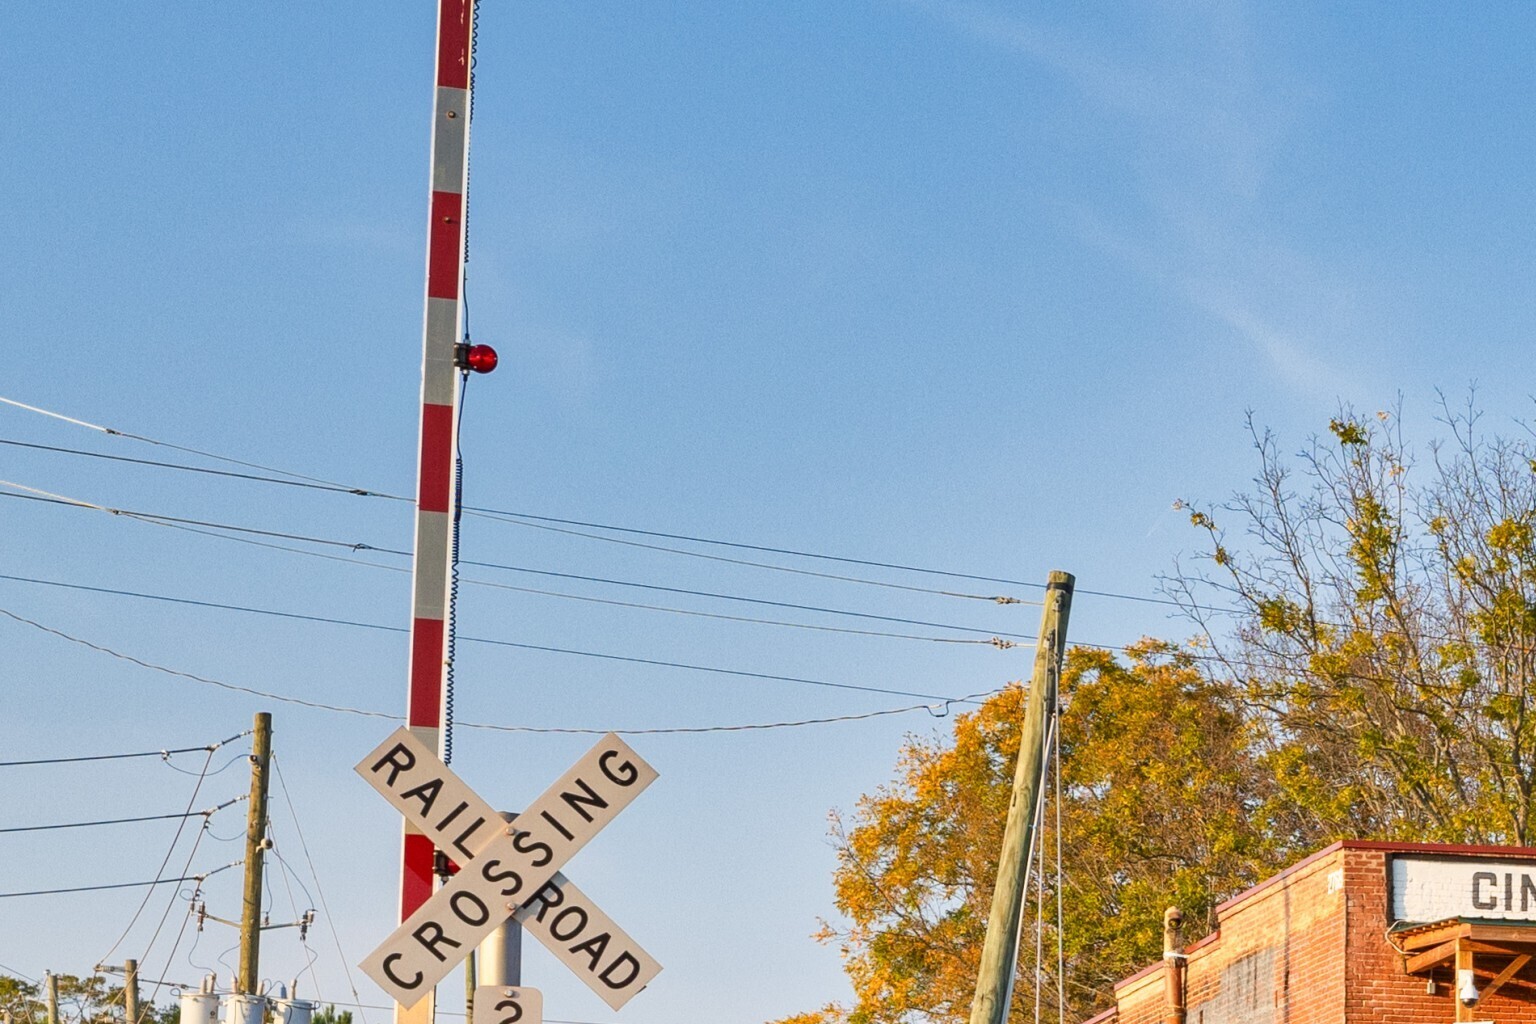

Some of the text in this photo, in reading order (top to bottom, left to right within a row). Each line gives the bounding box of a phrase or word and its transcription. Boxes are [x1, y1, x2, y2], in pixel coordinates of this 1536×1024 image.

[371, 742, 641, 990] RAIL ROAD
[382, 750, 639, 990] CROSSING
